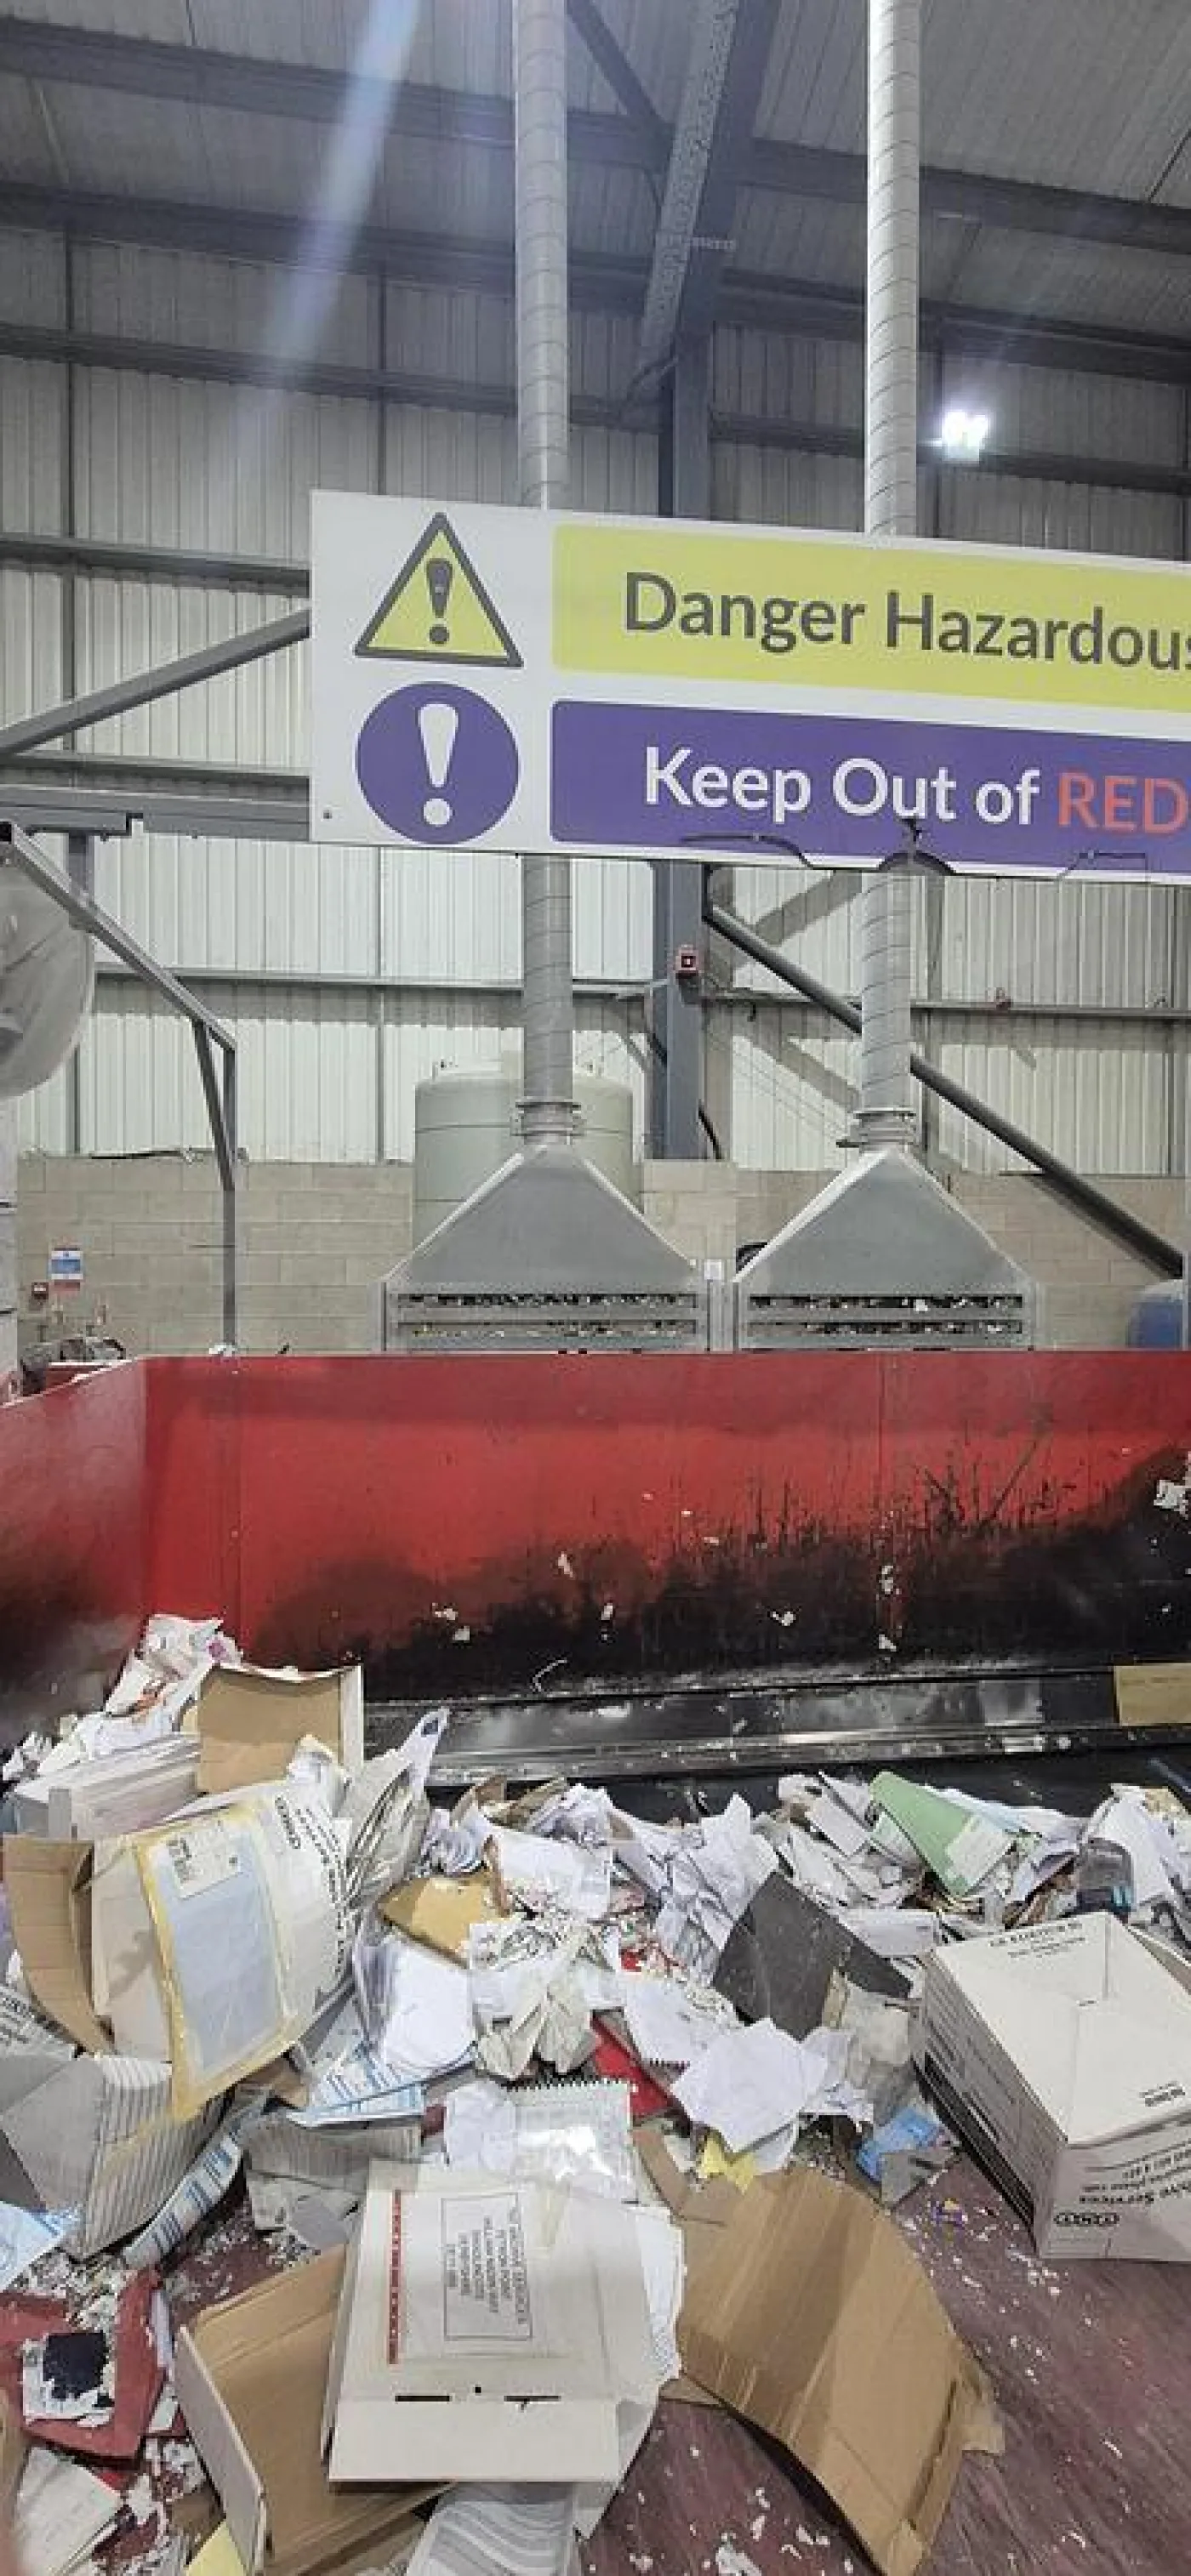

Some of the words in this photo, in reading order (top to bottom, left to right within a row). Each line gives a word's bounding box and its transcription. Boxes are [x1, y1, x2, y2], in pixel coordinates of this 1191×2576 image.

[625, 571, 866, 654] Danger
[645, 744, 812, 825] Keep
[832, 756, 957, 821] Out
[975, 767, 1041, 825] of
[1056, 771, 1189, 834] RED
